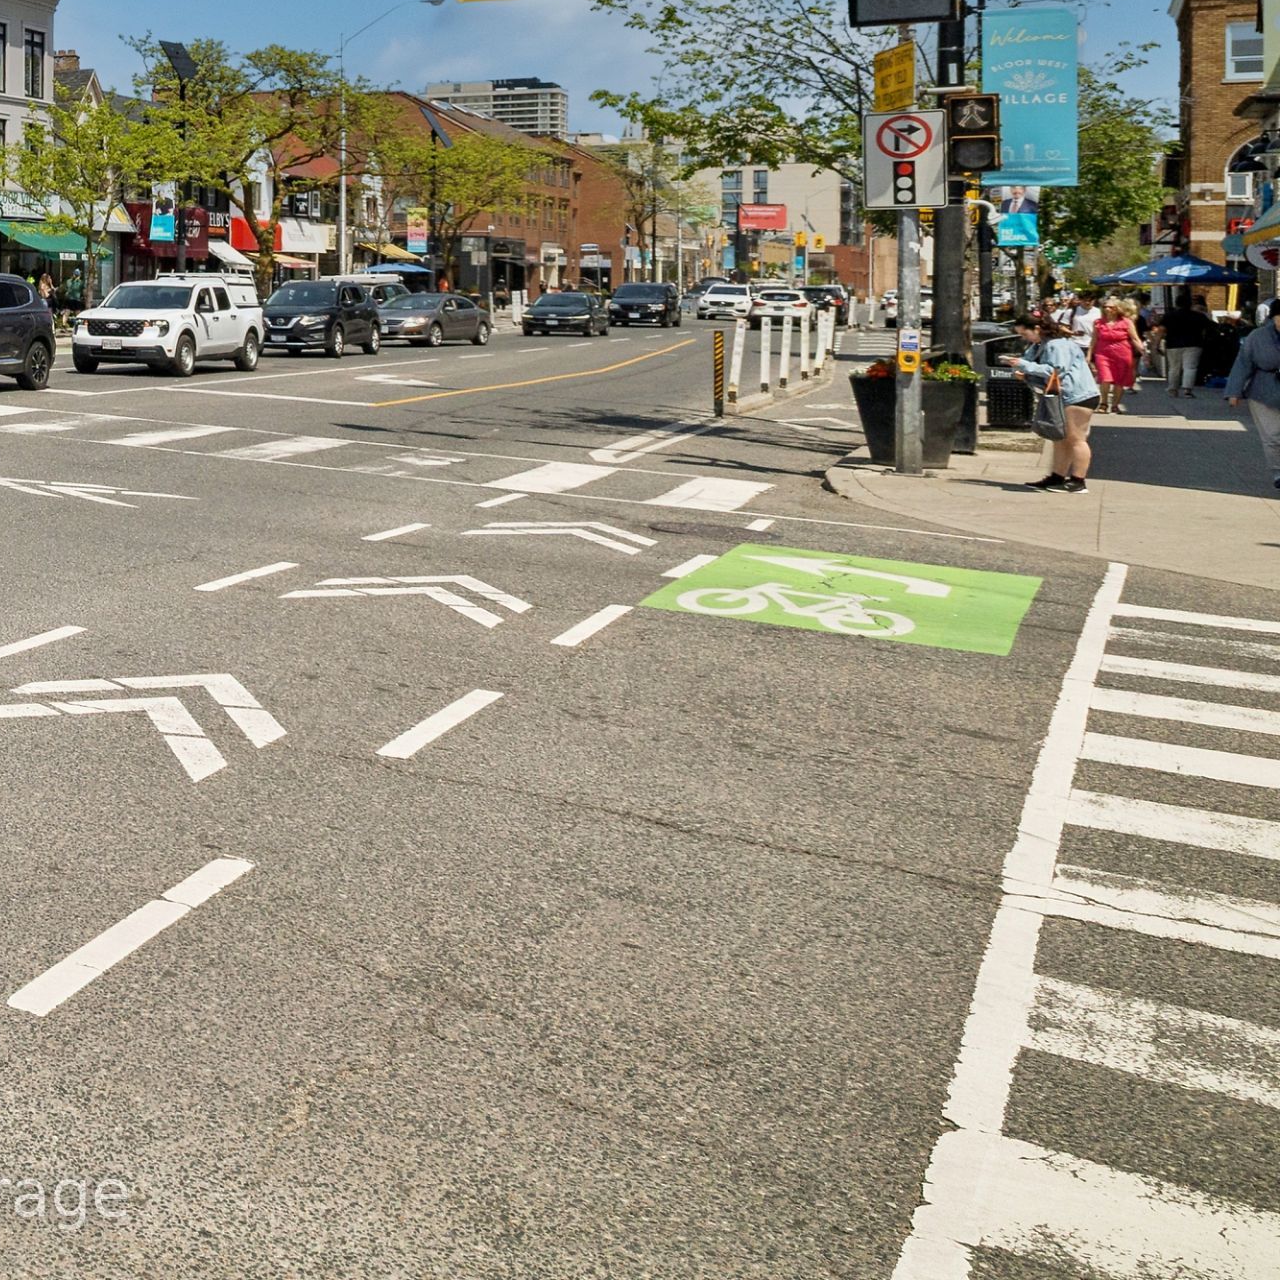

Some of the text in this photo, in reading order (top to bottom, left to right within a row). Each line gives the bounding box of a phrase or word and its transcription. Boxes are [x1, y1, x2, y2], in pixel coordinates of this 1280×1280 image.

[990, 27, 1071, 46] Welcome
[991, 59, 1069, 72] BLOOR WEST
[1000, 93, 1069, 104] ILLAGE
[991, 370, 1013, 378] Litter
